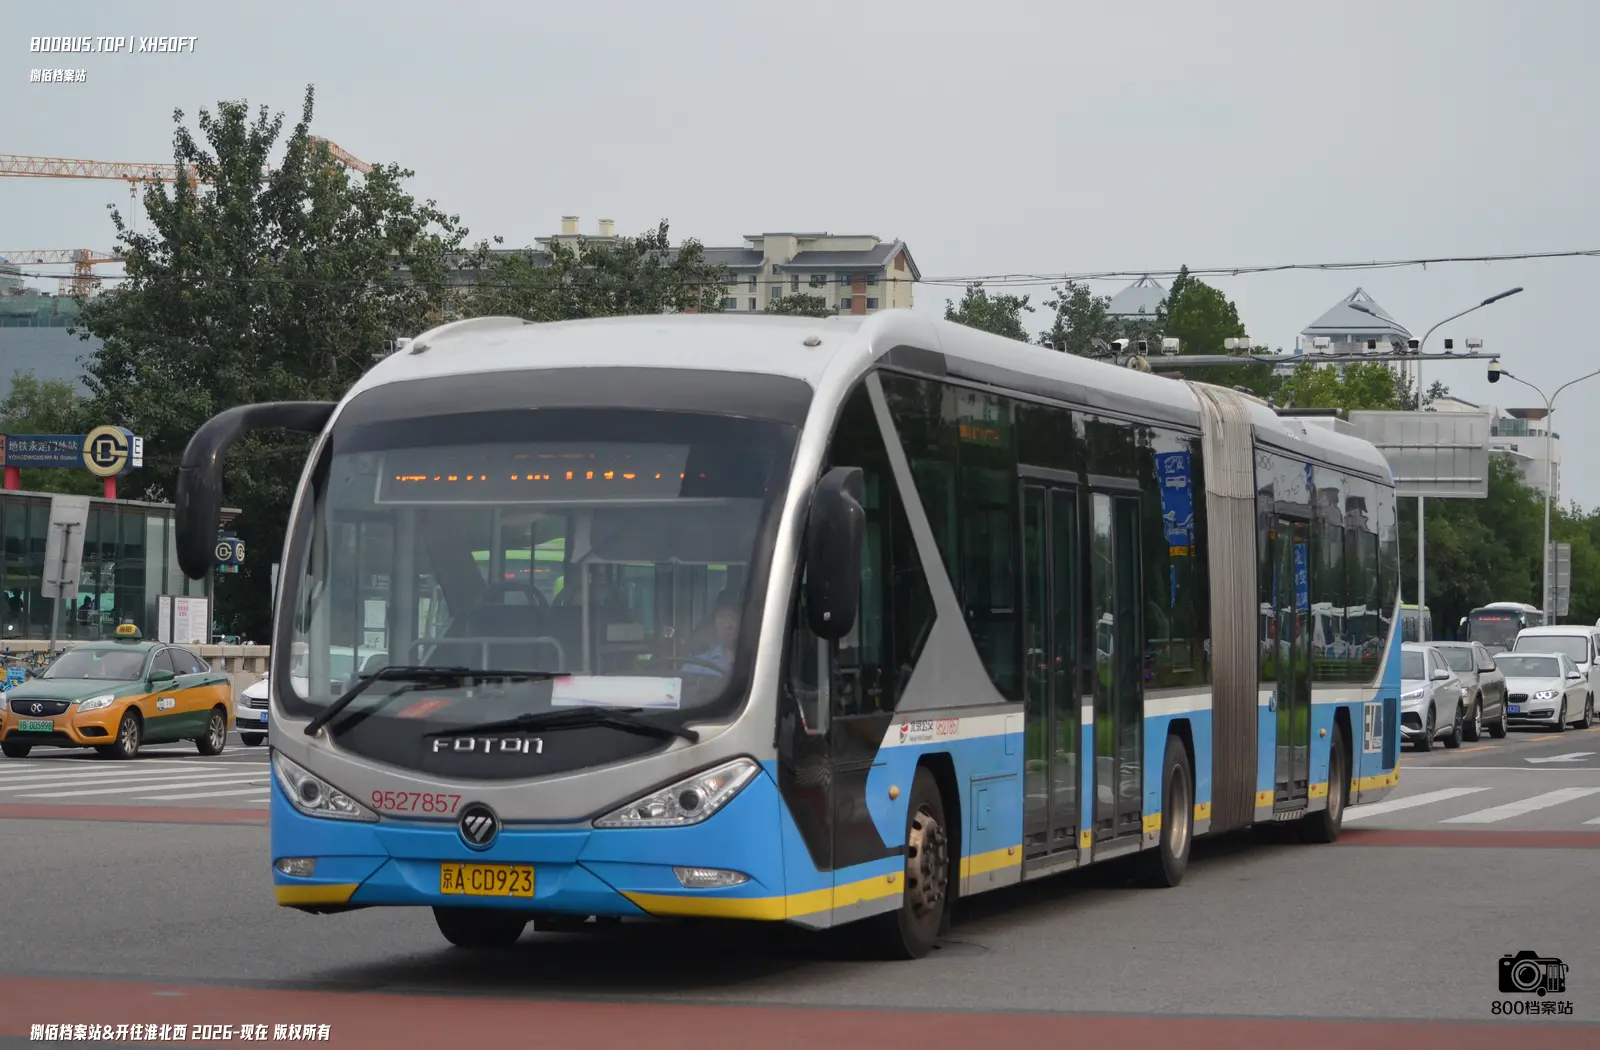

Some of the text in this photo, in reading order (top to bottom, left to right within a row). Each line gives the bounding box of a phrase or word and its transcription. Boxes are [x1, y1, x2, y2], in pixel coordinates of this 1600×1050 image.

[135, 438, 141, 454] E
[432, 737, 544, 754] FOTON
[371, 790, 462, 813] 9527857
